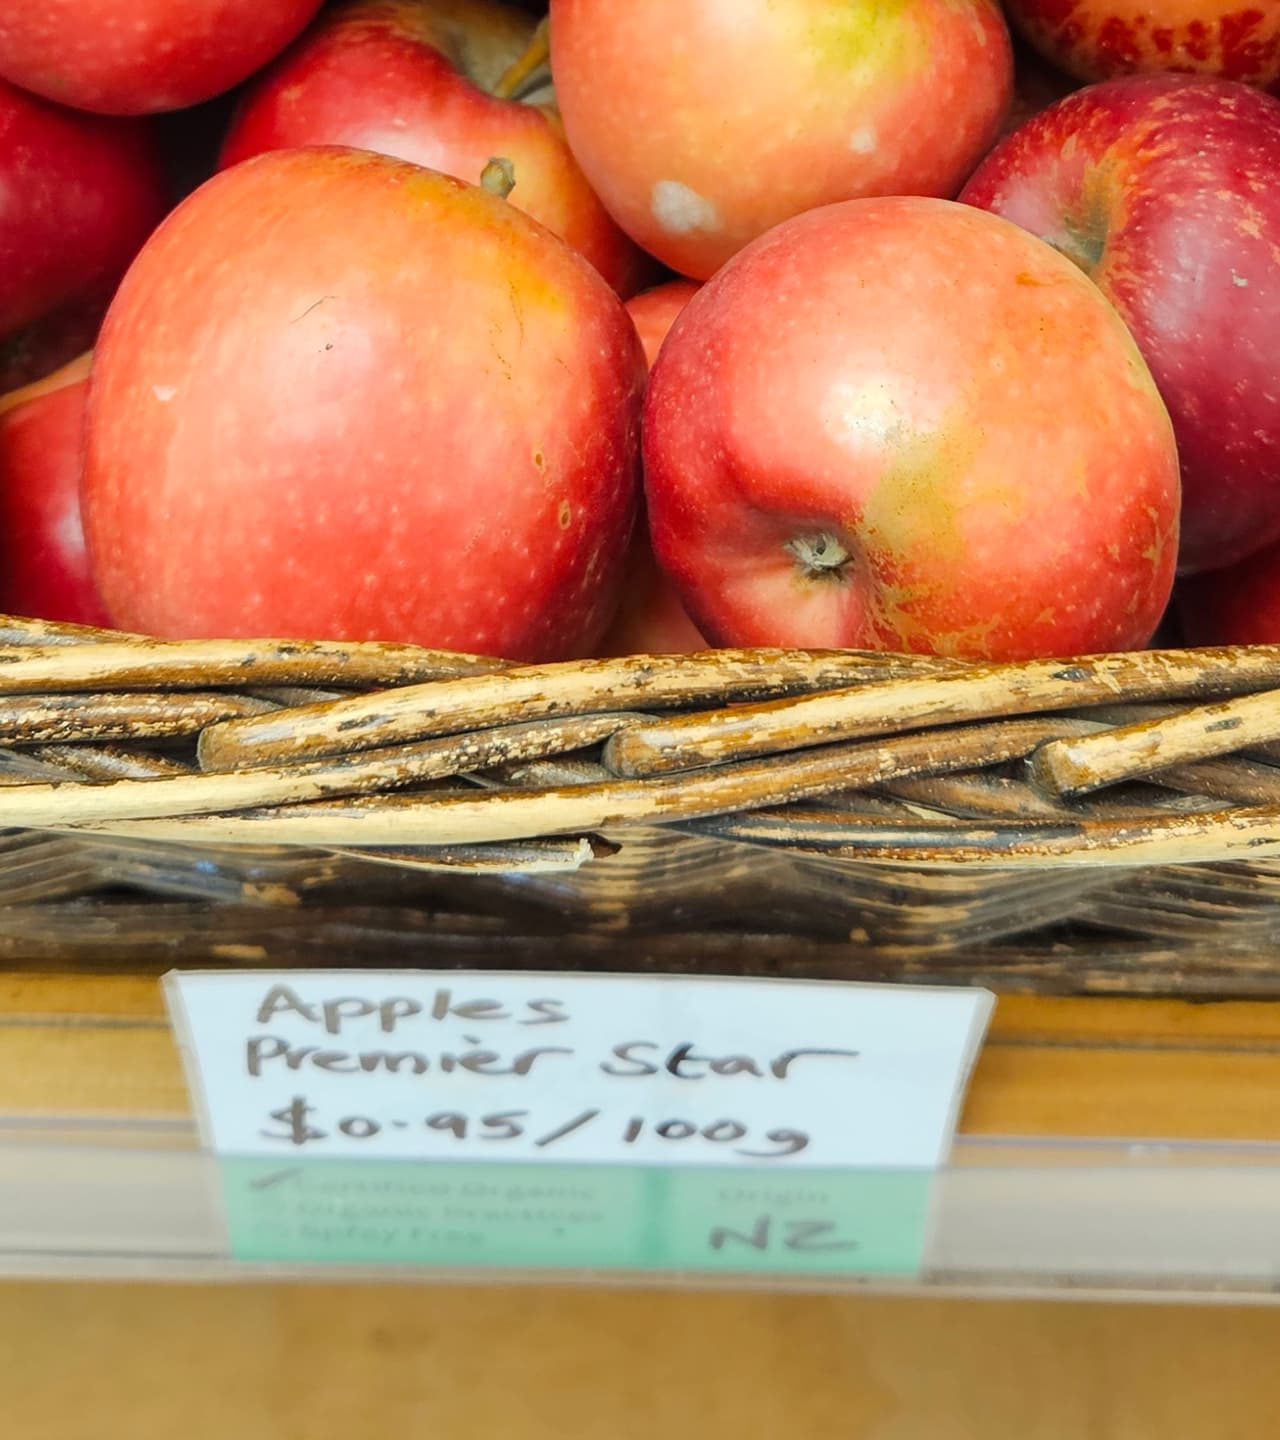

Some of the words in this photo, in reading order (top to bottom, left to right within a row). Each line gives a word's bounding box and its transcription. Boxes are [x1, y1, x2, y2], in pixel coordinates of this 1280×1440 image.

[256, 983, 571, 1035] Apples
[245, 1034, 576, 1077] Premier
[598, 1040, 861, 1080] Star
[708, 1212, 862, 1253] NZ
